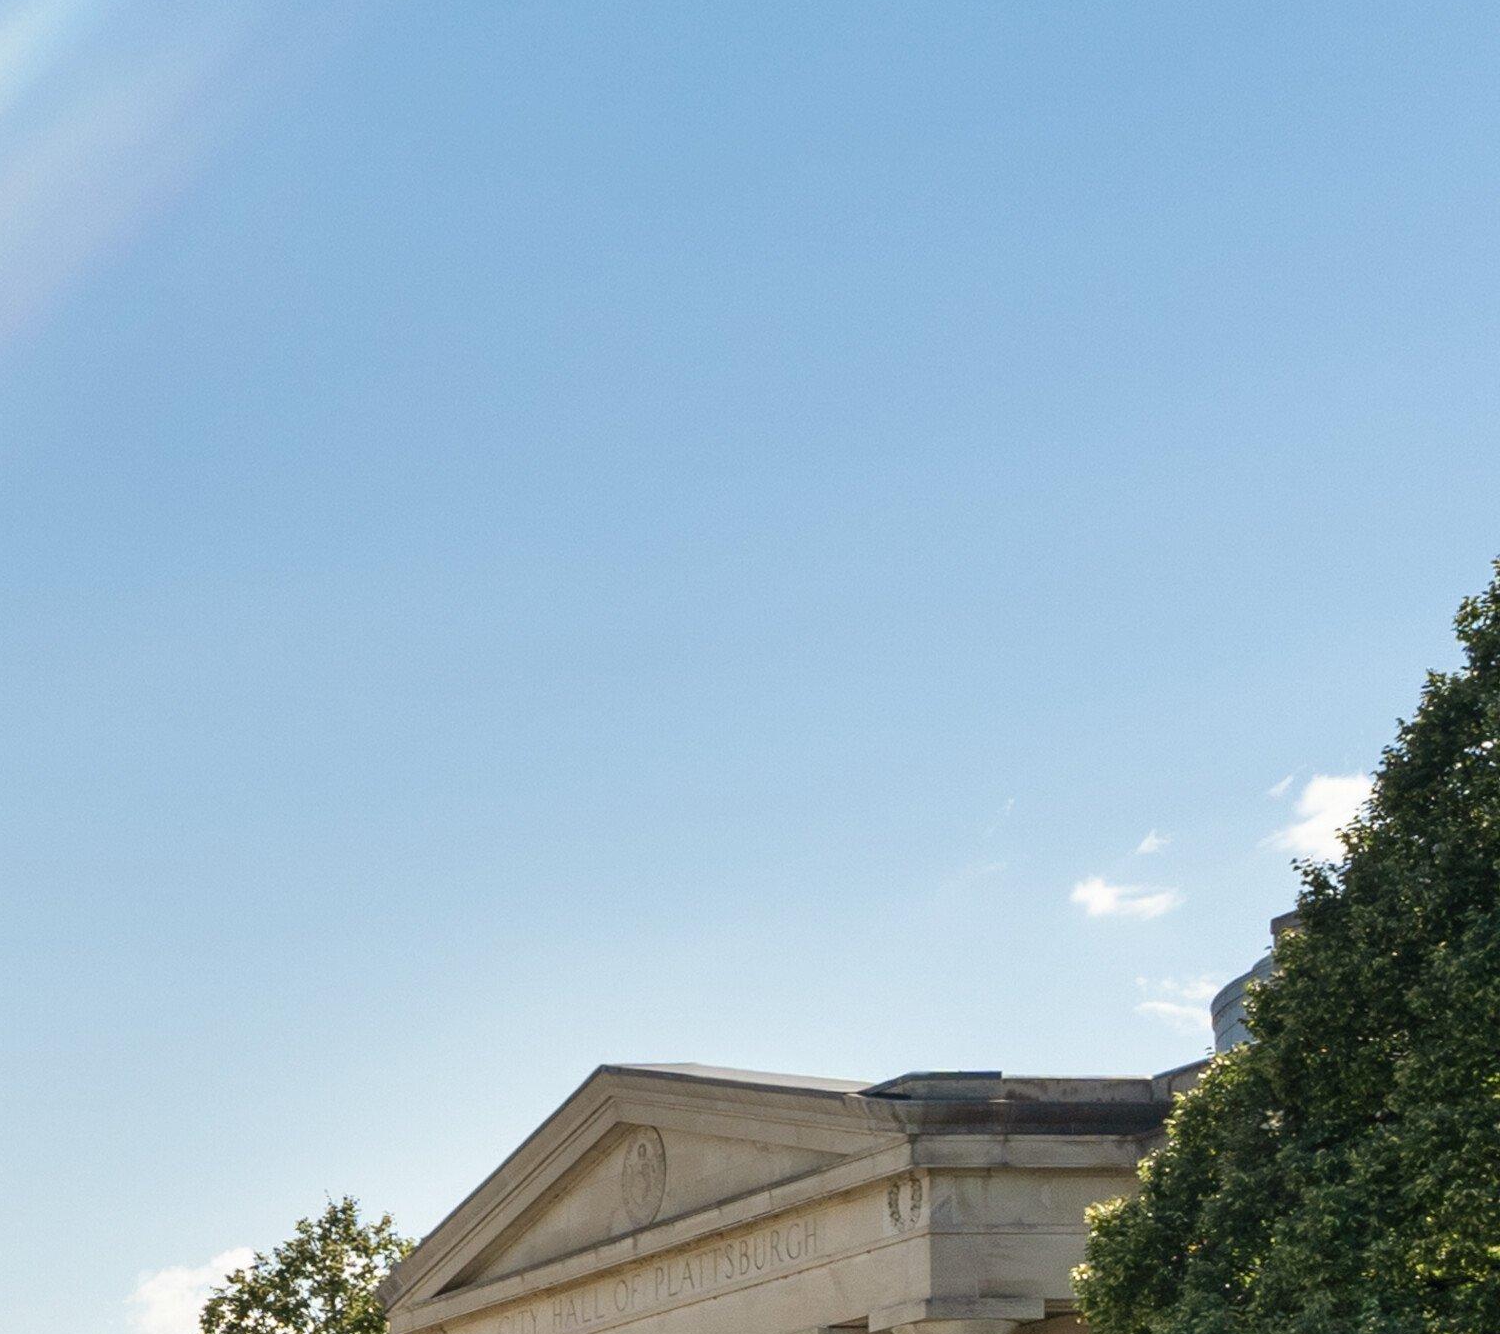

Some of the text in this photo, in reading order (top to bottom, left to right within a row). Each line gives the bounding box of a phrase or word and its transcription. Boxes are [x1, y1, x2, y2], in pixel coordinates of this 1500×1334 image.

[552, 1288, 605, 1328] HALL
[613, 1274, 642, 1312] OF
[654, 1219, 817, 1301] PLATTSBURGH
